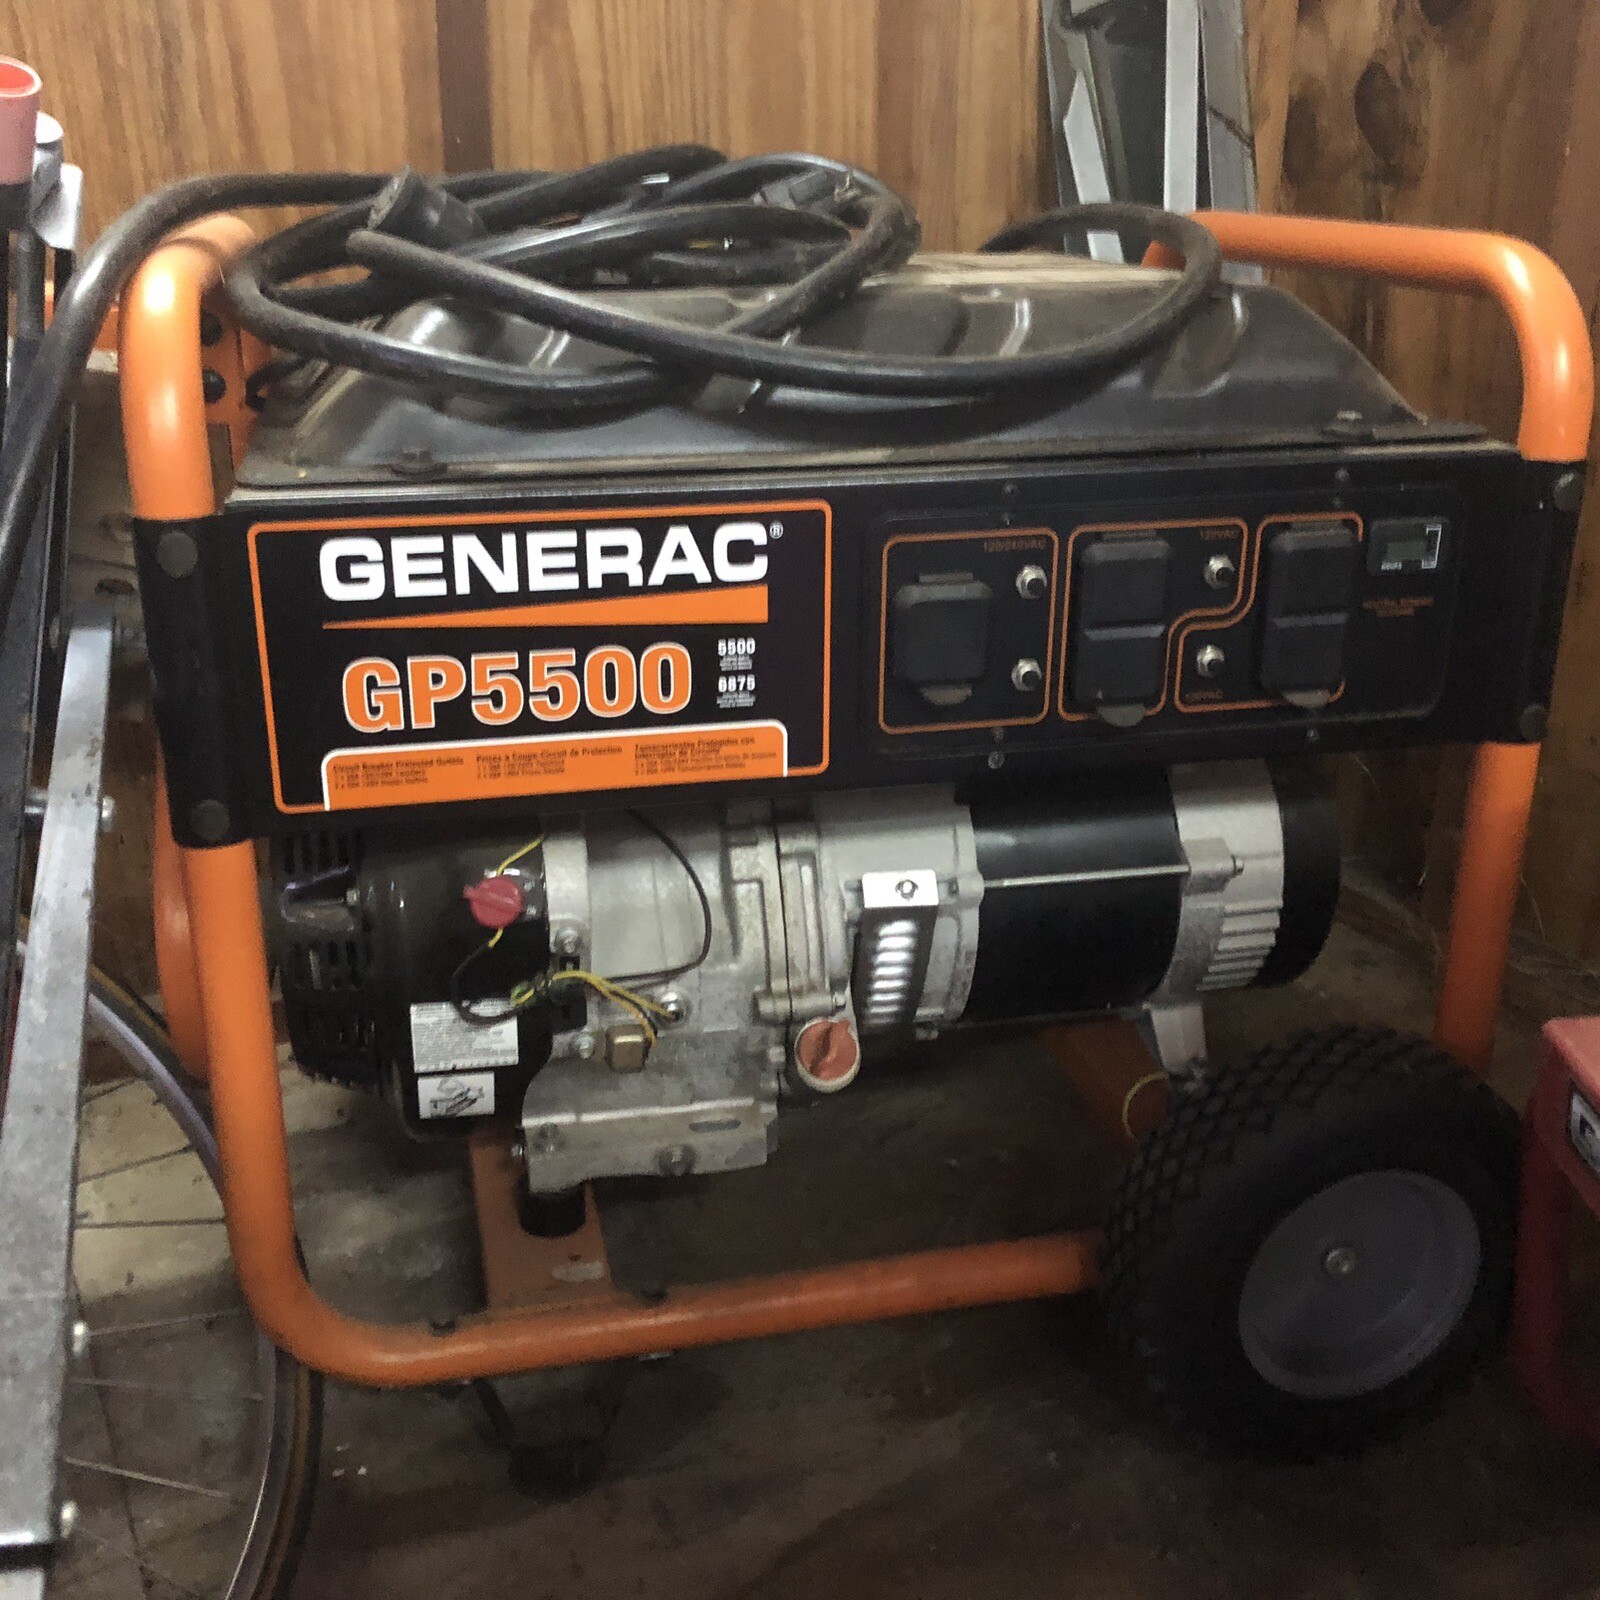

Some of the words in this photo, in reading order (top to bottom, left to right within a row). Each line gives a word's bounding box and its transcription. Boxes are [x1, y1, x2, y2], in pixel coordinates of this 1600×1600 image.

[319, 521, 768, 601] GENERAC
[718, 637, 756, 656] 5500
[342, 641, 692, 734] GP5500
